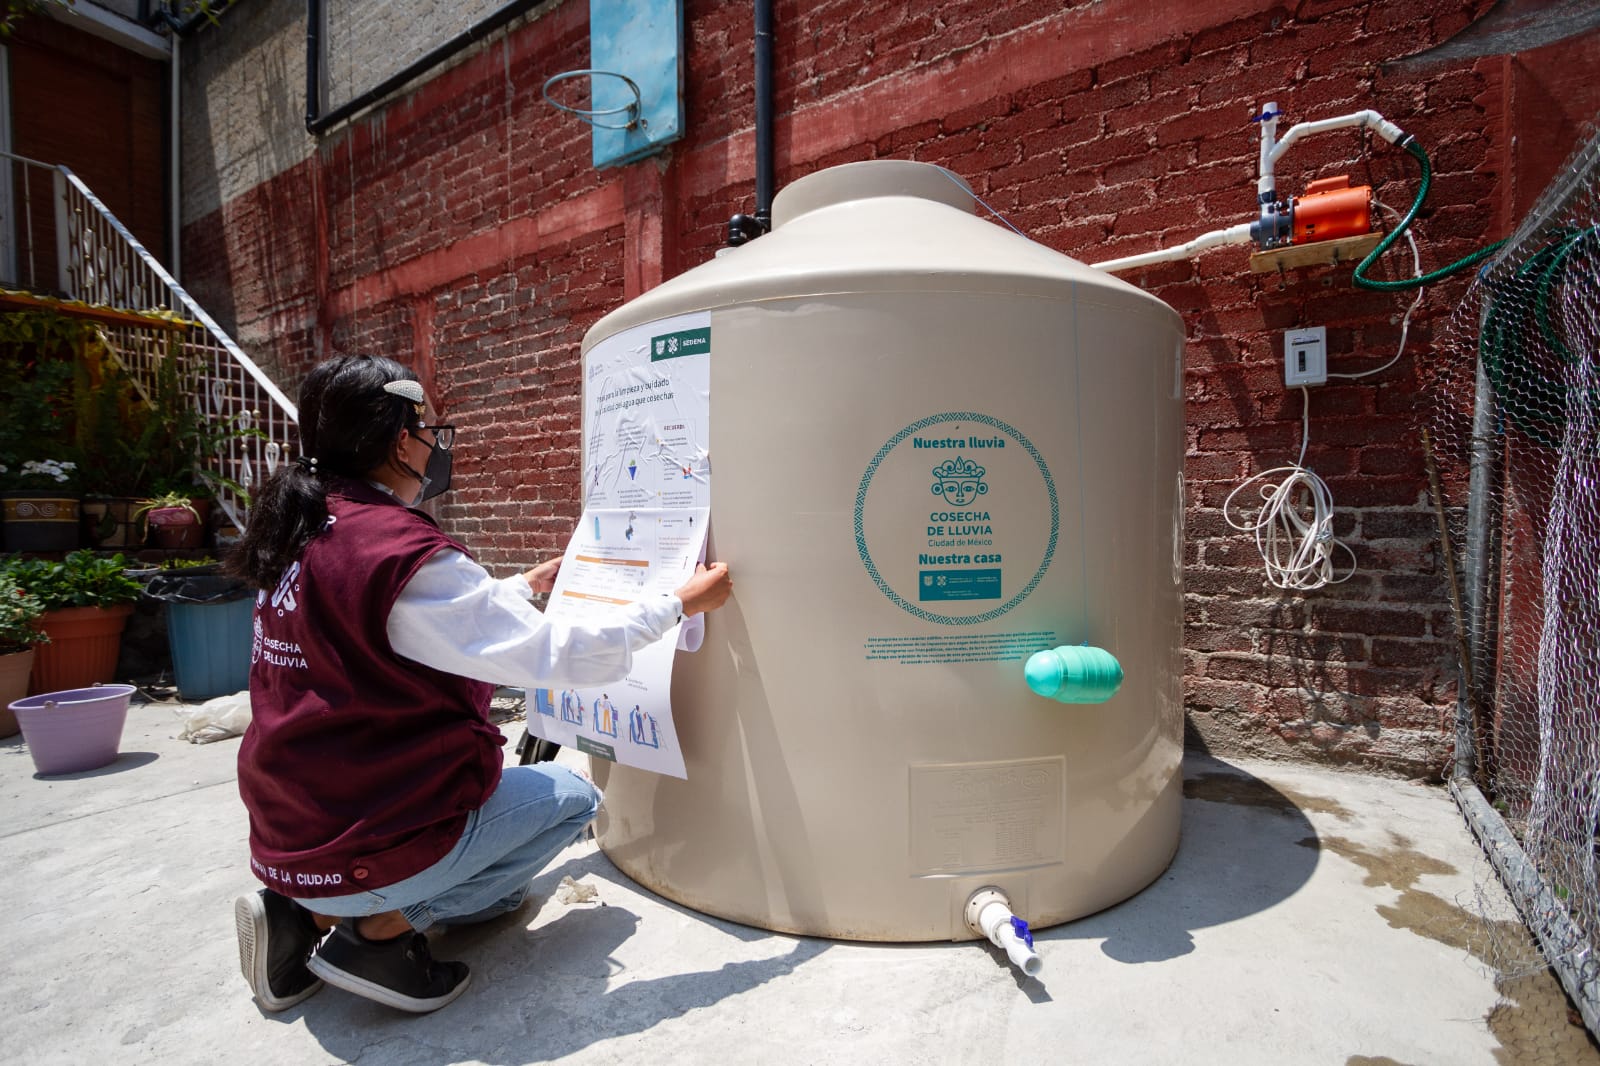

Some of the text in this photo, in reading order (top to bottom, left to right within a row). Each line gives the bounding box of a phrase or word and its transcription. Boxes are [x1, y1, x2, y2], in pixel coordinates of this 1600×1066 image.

[682, 337, 706, 346] SEDEMA
[635, 397, 646, 406] que
[646, 391, 674, 403] cosechas
[913, 436, 1005, 449] Nuestra lluvia
[930, 511, 991, 522] COSECHA
[927, 525, 993, 536] DE LLUVIA
[928, 539, 955, 547] Ciudad
[956, 538, 966, 547] de
[918, 553, 1002, 565] Nuestra casa
[268, 866, 278, 880] DE
[280, 869, 292, 884] LA
[296, 873, 342, 886] CIUDAD
